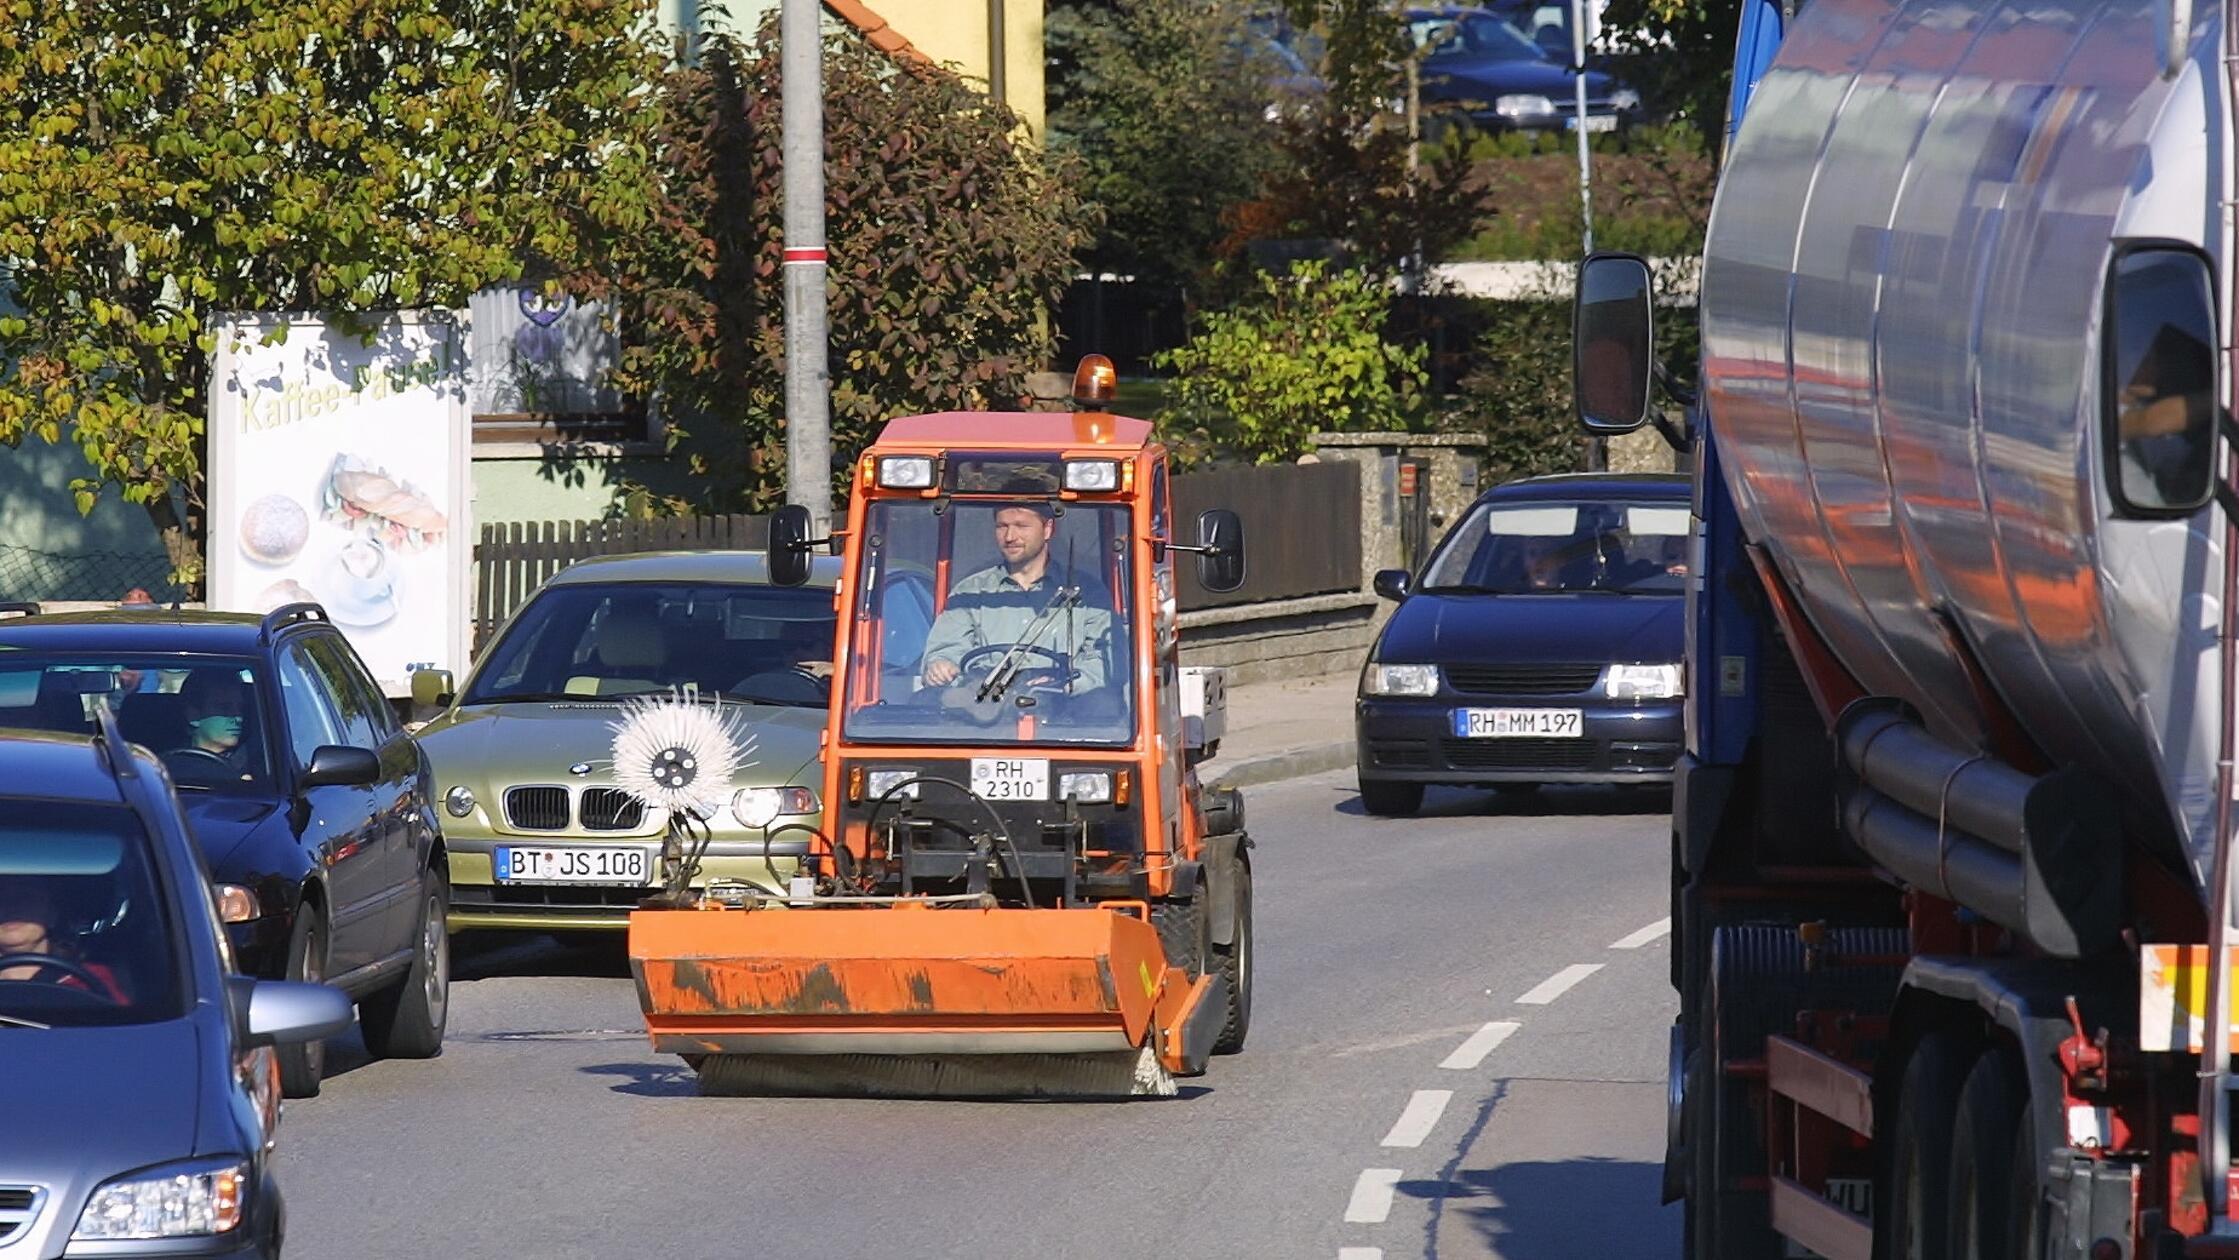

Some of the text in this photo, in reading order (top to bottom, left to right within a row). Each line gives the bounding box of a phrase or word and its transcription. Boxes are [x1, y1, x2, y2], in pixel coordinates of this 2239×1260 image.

[1470, 713, 1495, 732] RH
[1509, 713, 1535, 732] MM
[1541, 713, 1577, 732] 197
[996, 761, 1023, 778] RH
[986, 781, 1033, 797] 2310
[511, 851, 642, 875] BT JS 108
